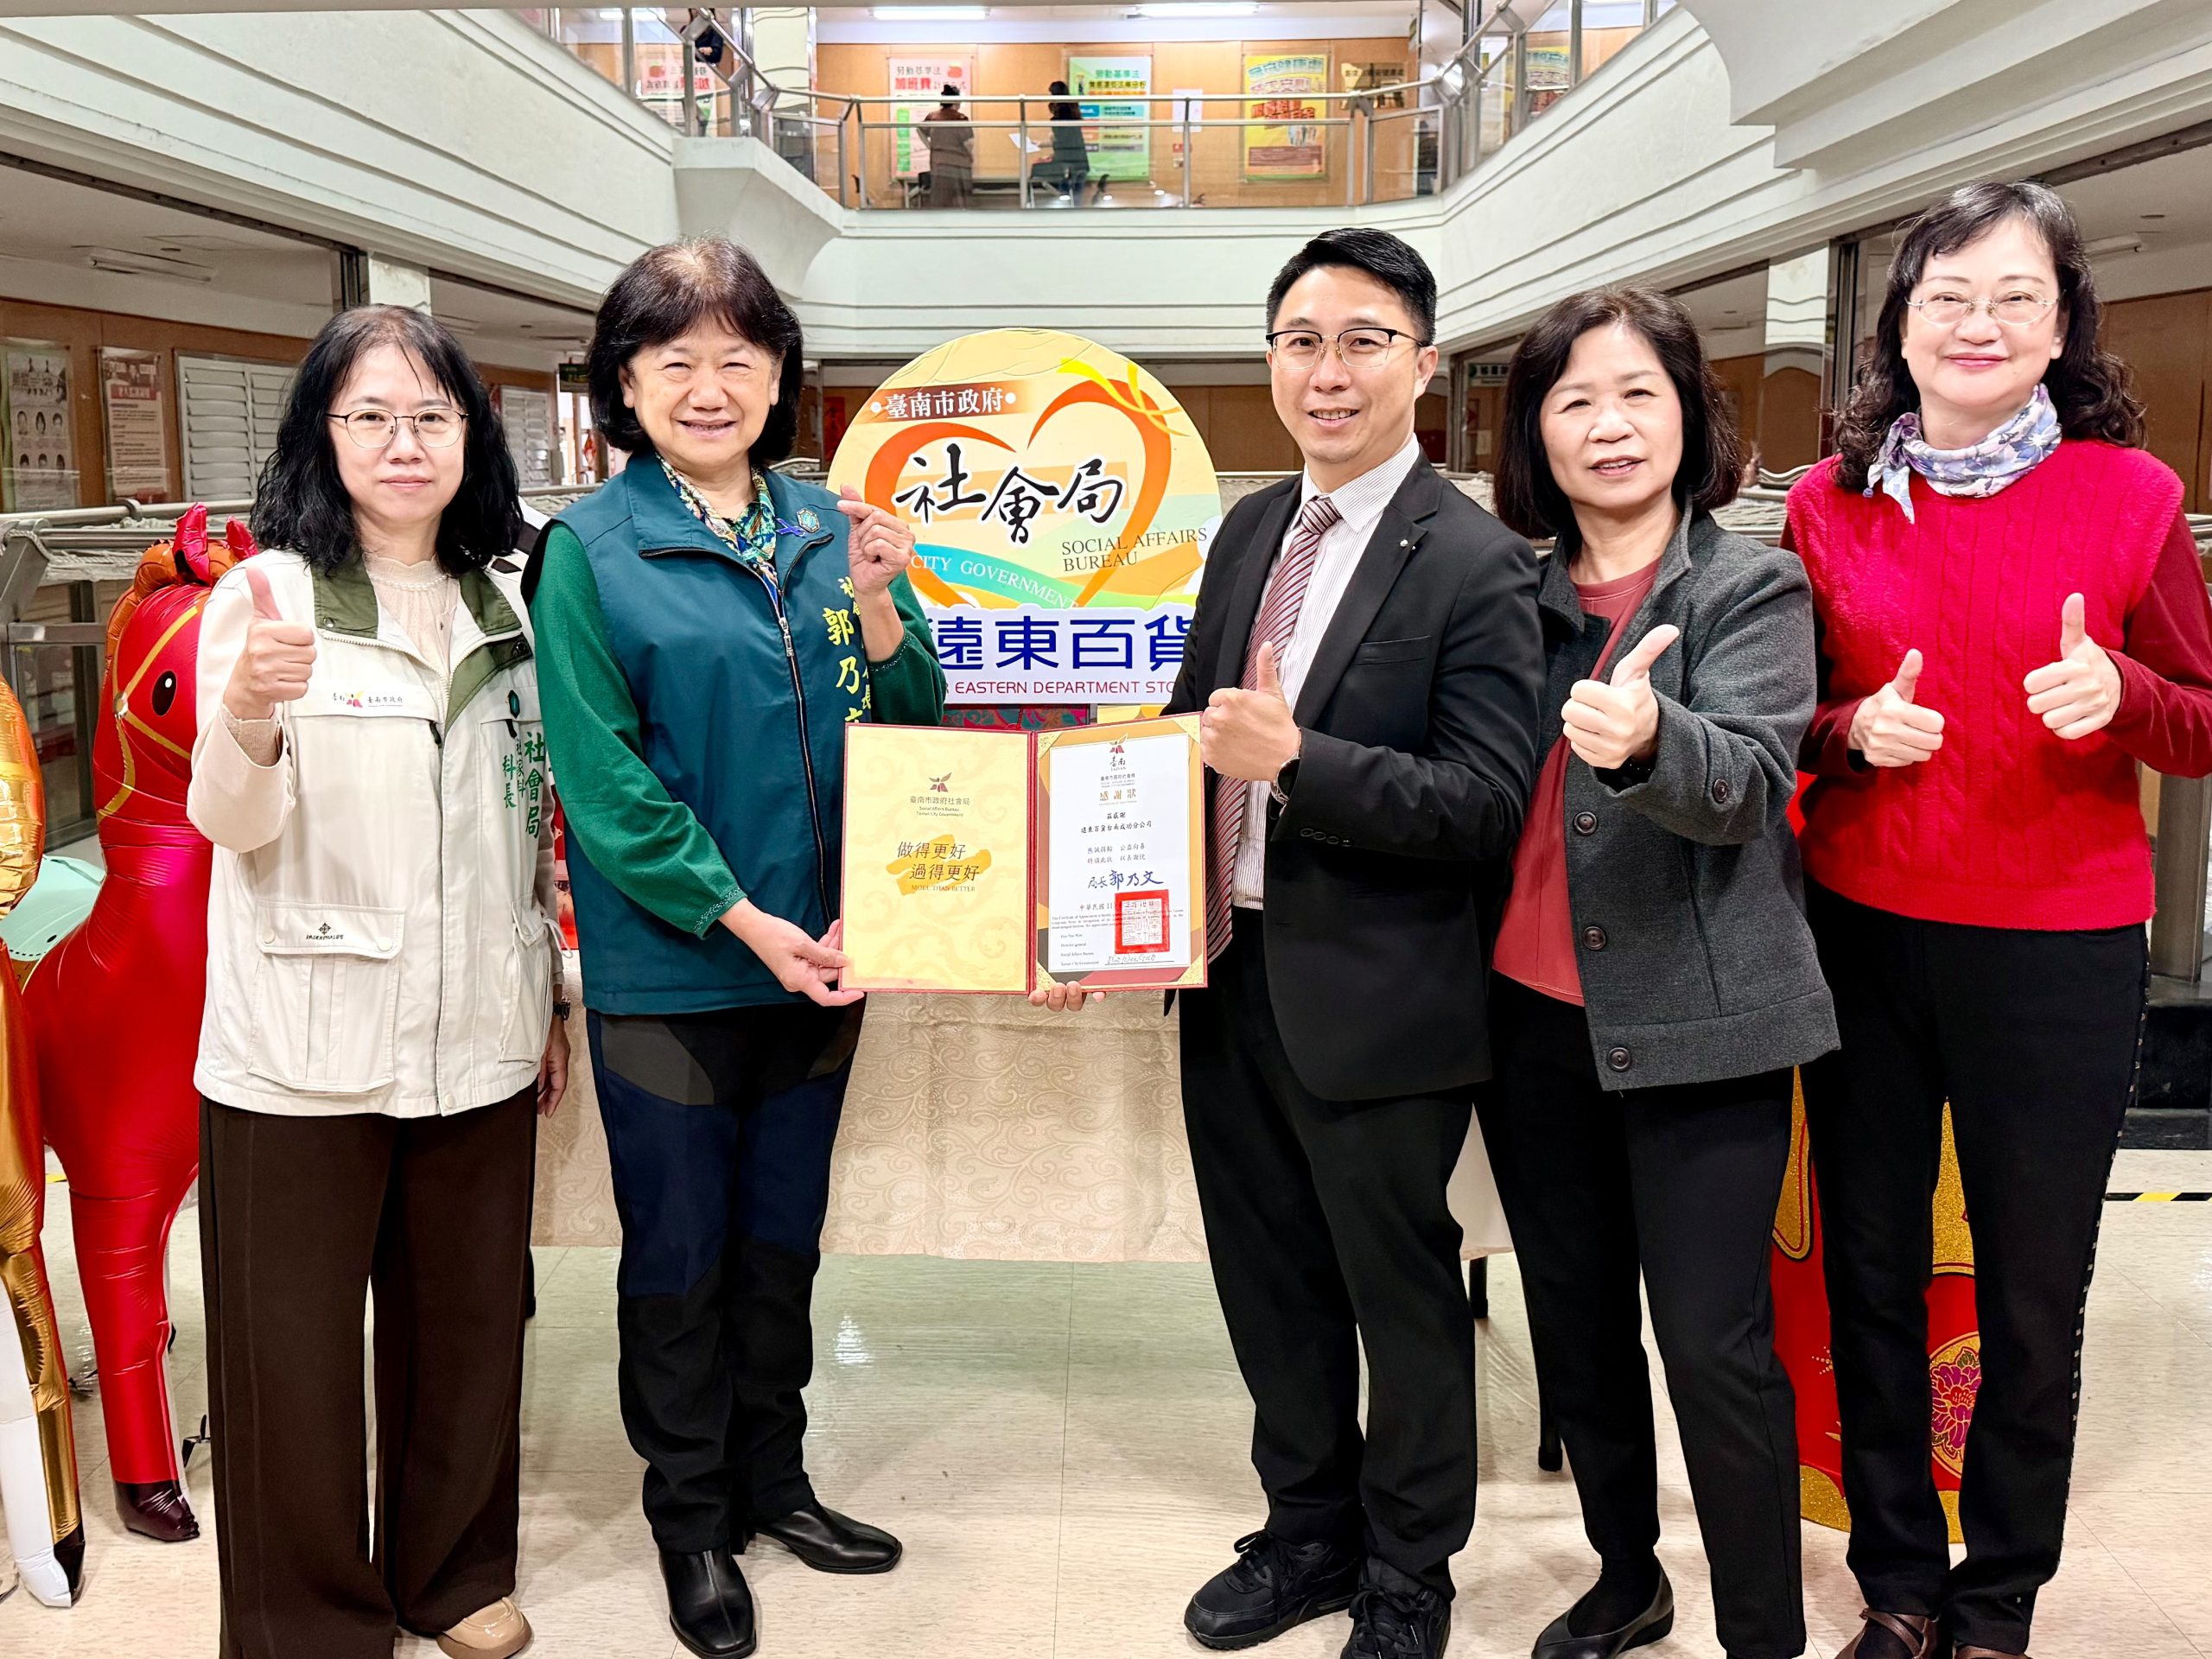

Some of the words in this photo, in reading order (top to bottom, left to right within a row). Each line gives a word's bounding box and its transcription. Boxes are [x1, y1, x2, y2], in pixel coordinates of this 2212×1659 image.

[885, 386, 1004, 419] 臺南市政府
[896, 443, 1123, 544] 社會局
[1061, 536, 1129, 556] SOCIAL
[1133, 526, 1208, 547] AFFAIRS
[1064, 550, 1138, 572] BUREAU
[911, 554, 952, 570] CITY
[960, 560, 1078, 609] GOVERNMENT
[955, 681, 1027, 694] EASTERN
[1034, 681, 1140, 694] DEPARTMENT
[502, 753, 518, 810] 科長
[524, 732, 546, 839] 社會局
[910, 795, 970, 806] 臺南市政府社會局
[1099, 788, 1137, 802] 感謝狀
[897, 841, 966, 860] 做得更好
[909, 863, 980, 881] 過得更好
